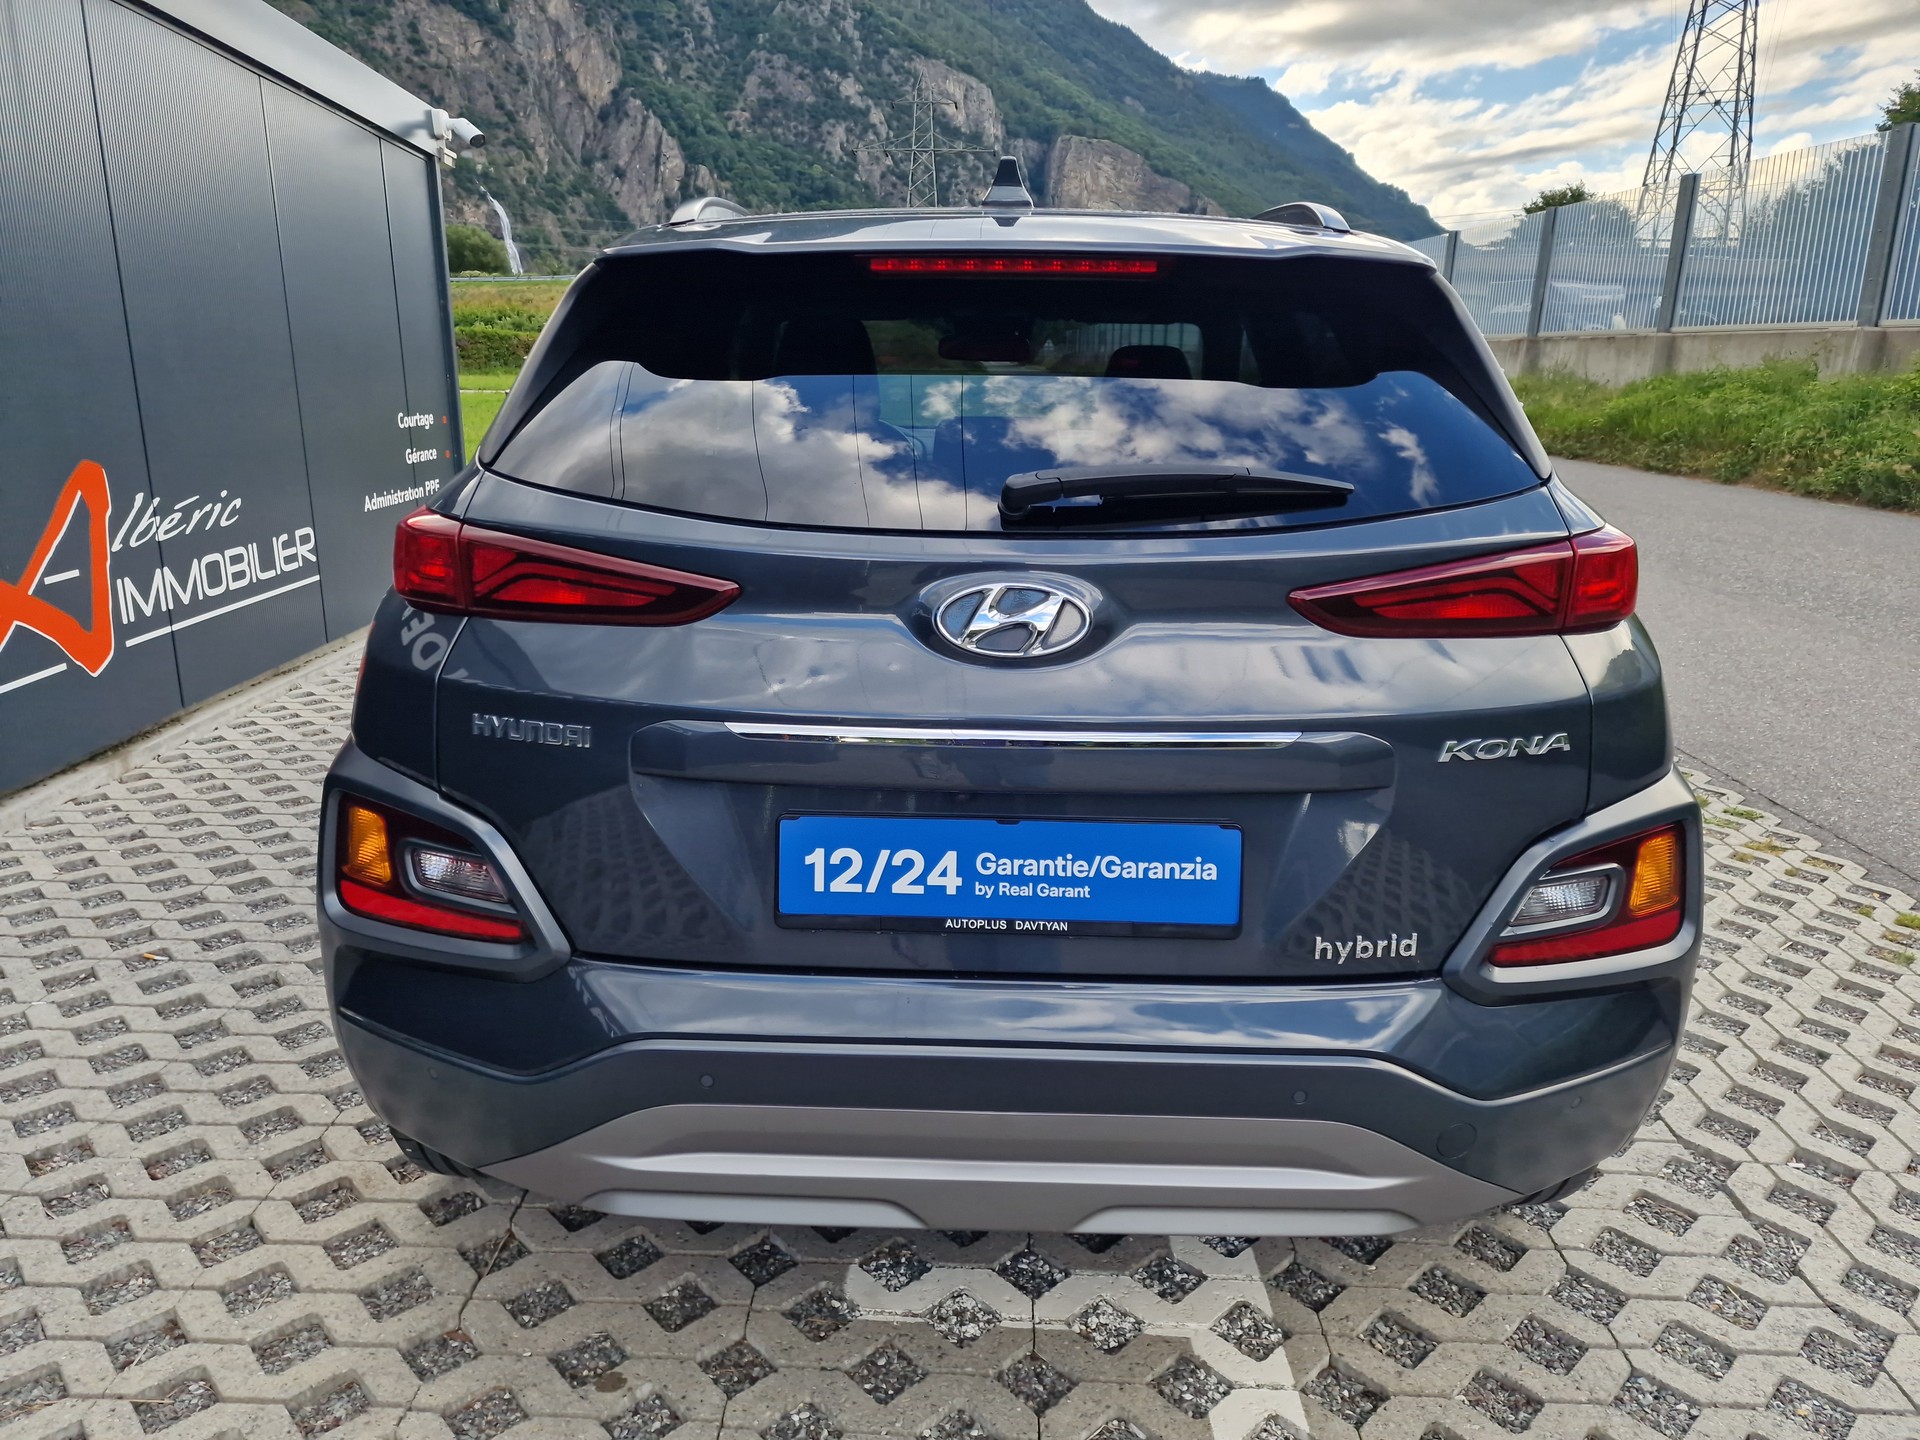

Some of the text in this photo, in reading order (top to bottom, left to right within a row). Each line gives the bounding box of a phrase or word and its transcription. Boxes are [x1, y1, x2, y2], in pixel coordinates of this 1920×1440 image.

[397, 412, 434, 430] Courtage
[405, 447, 437, 465] Gérance
[364, 486, 425, 513] Administration
[116, 526, 317, 625] IMMOBILIER
[472, 712, 592, 748] HYUNDAI
[1437, 732, 1571, 763] KONA
[804, 847, 963, 895] 12/24
[975, 852, 1218, 881] Garantie/Garanzia
[975, 882, 1091, 899] by Real Garant
[945, 919, 1068, 932] AUTOPLUS DAVTYAN
[1314, 932, 1418, 965] hybrid
